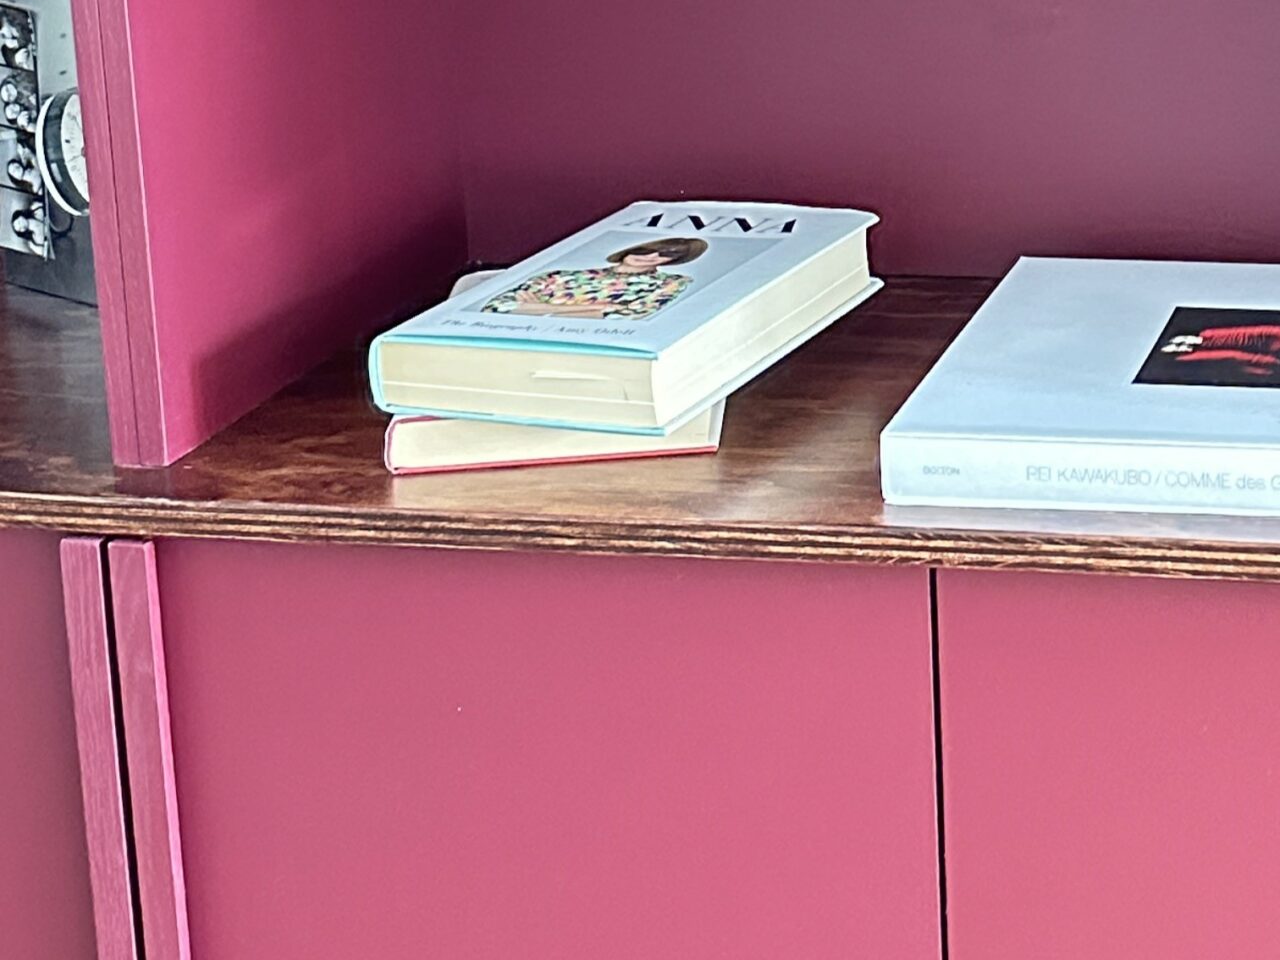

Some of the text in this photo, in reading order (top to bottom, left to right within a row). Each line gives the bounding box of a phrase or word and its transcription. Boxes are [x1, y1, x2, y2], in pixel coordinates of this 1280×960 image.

[621, 212, 797, 234] ANNA
[1026, 465, 1053, 482] REI
[1057, 467, 1153, 487] KAWAKUBO
[1164, 472, 1232, 490] COMME
[1236, 473, 1267, 490] des
